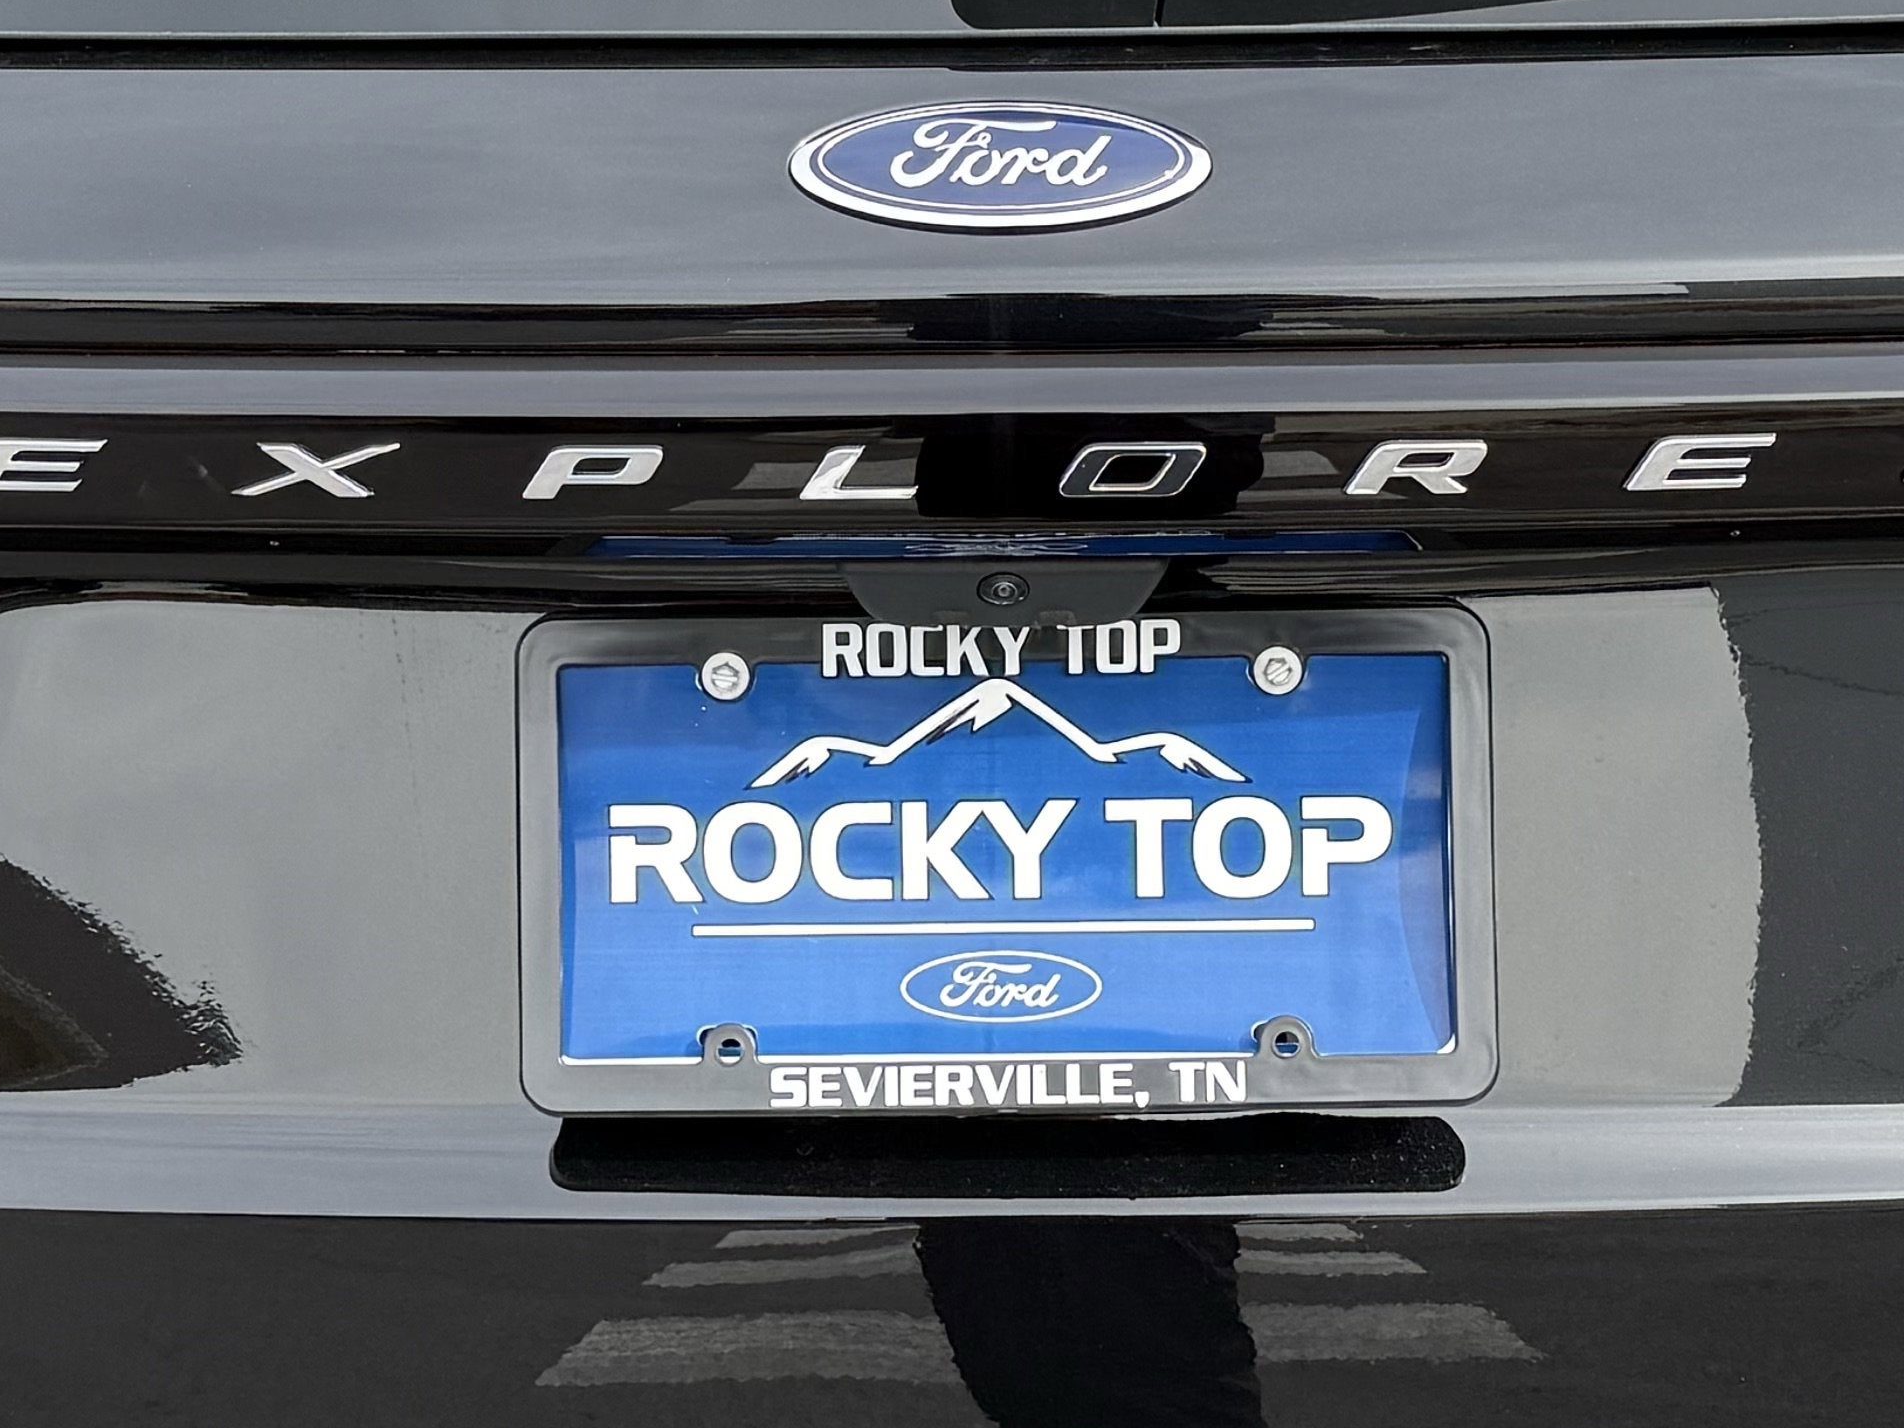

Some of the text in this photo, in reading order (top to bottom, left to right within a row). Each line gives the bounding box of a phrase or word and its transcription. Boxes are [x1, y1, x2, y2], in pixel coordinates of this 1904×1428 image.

[890, 118, 1112, 188] Ford
[821, 619, 1182, 678] ROCKY TOP
[608, 796, 1393, 904] ROCKY TOP
[940, 961, 1059, 1012] Ford
[769, 1060, 1247, 1109] SEVIERVILLE, TN
